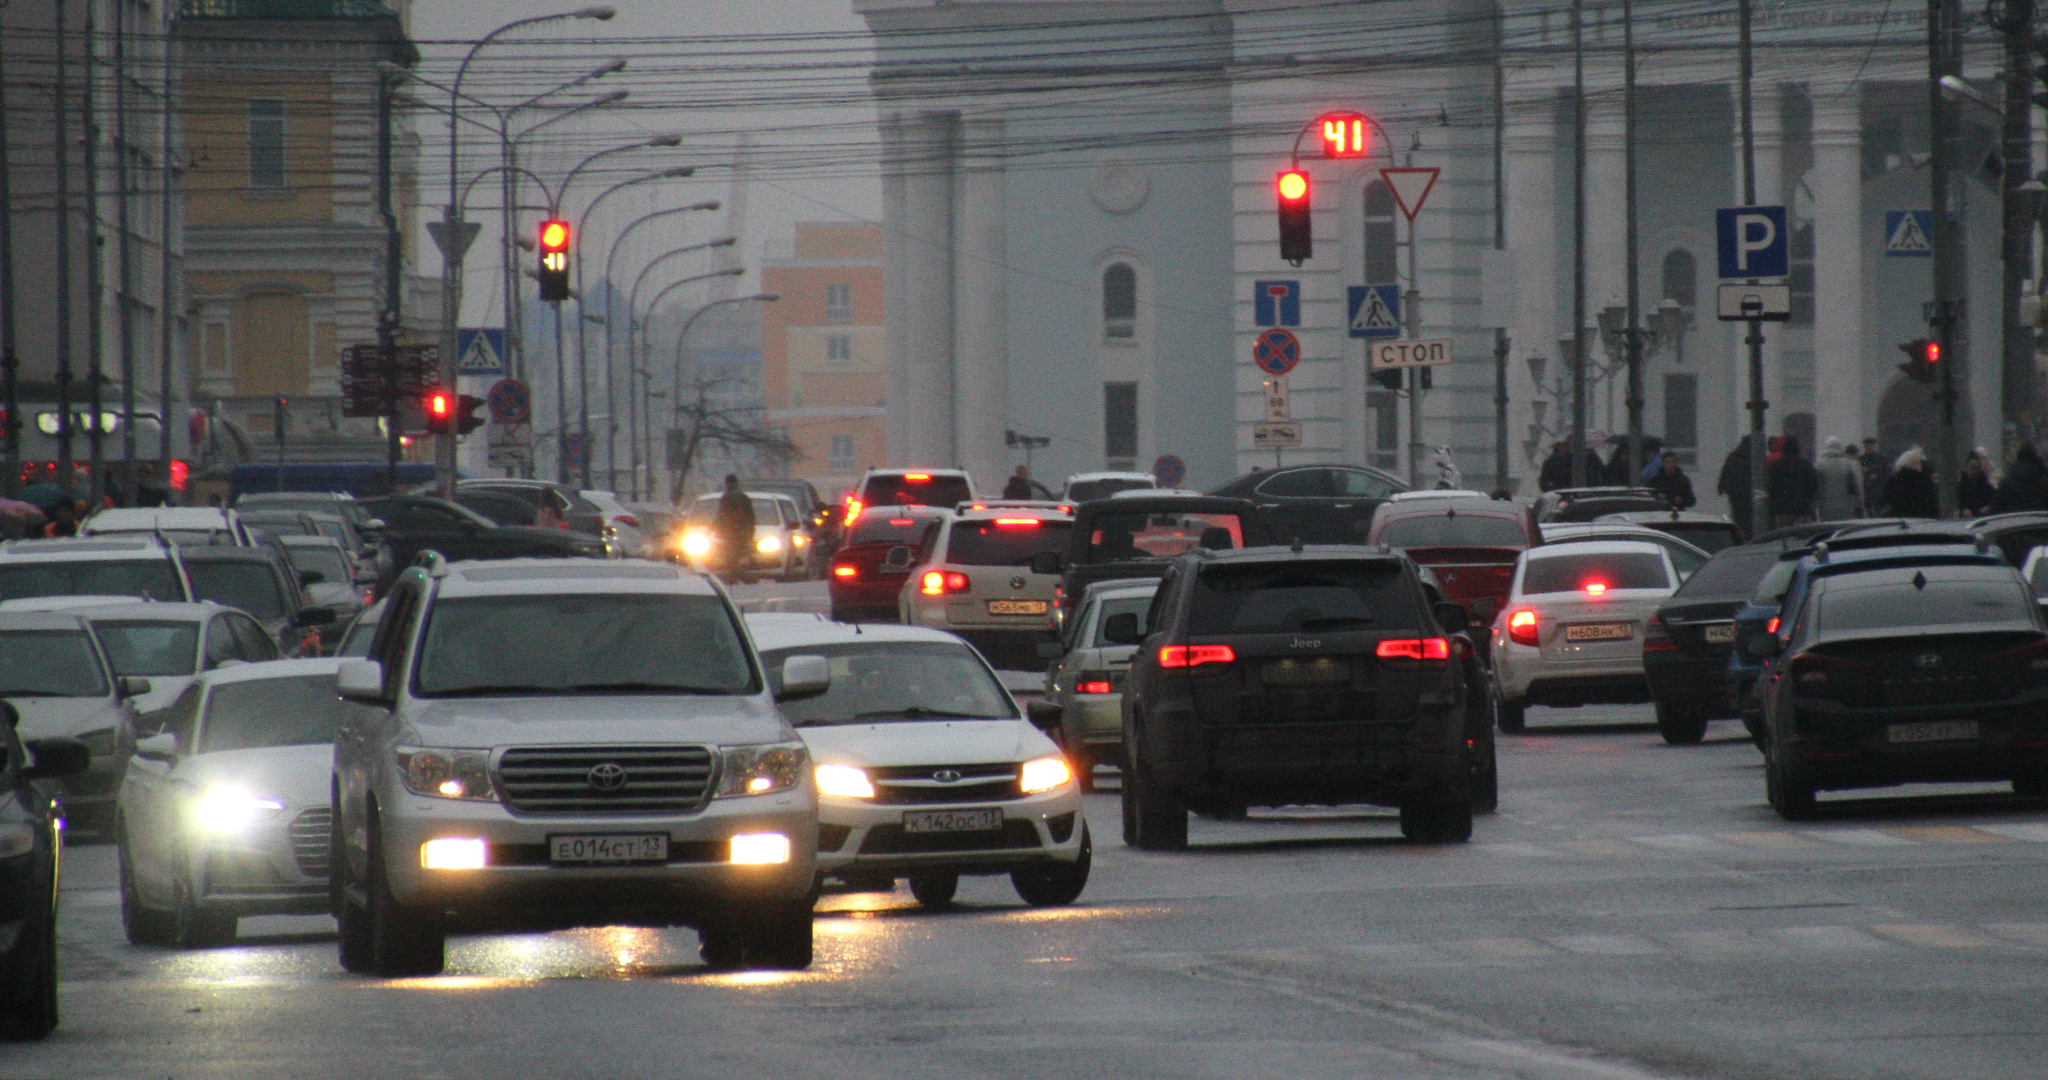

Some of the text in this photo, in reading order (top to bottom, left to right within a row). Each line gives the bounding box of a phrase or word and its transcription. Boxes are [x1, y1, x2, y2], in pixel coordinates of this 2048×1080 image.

[1324, 120, 1362, 152] 41
[1735, 213, 1777, 271] P
[1380, 342, 1445, 364] СТОП
[1289, 637, 1322, 650] Jeep
[982, 809, 997, 825] 13
[558, 836, 660, 859] Е014СТ 13
